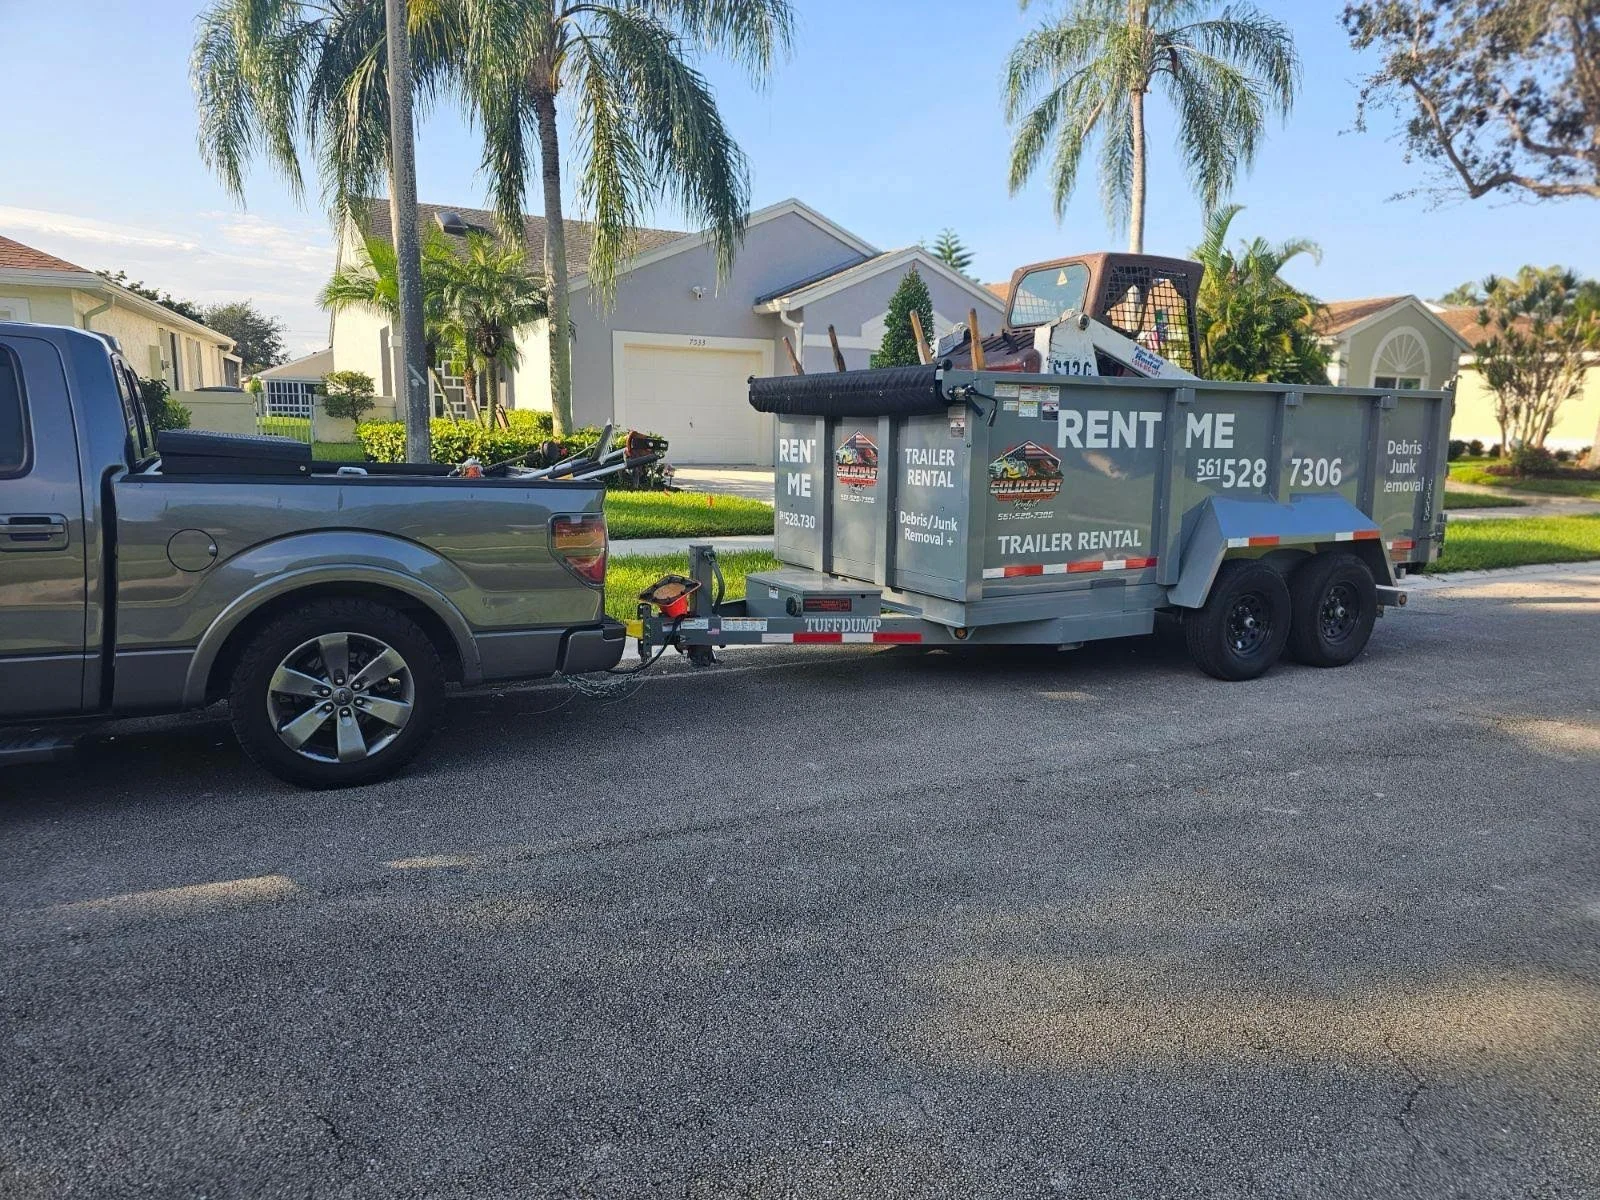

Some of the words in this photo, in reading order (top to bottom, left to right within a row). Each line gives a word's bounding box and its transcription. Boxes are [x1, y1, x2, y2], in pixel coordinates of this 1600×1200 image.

[1057, 409, 1163, 449] RENT
[1185, 412, 1235, 449] ME
[1387, 439, 1423, 455] Debris
[905, 448, 955, 467] TRAILER
[1389, 458, 1416, 474] Junk
[907, 469, 954, 488] RENTAL
[1289, 457, 1342, 487] 7306
[787, 472, 812, 498] ME
[900, 510, 958, 532] Debris/Junk
[904, 527, 944, 546] Removal
[997, 531, 1073, 555] TRAILER
[1077, 529, 1142, 551] RENTAL
[804, 618, 882, 633] TUFFDUMP
